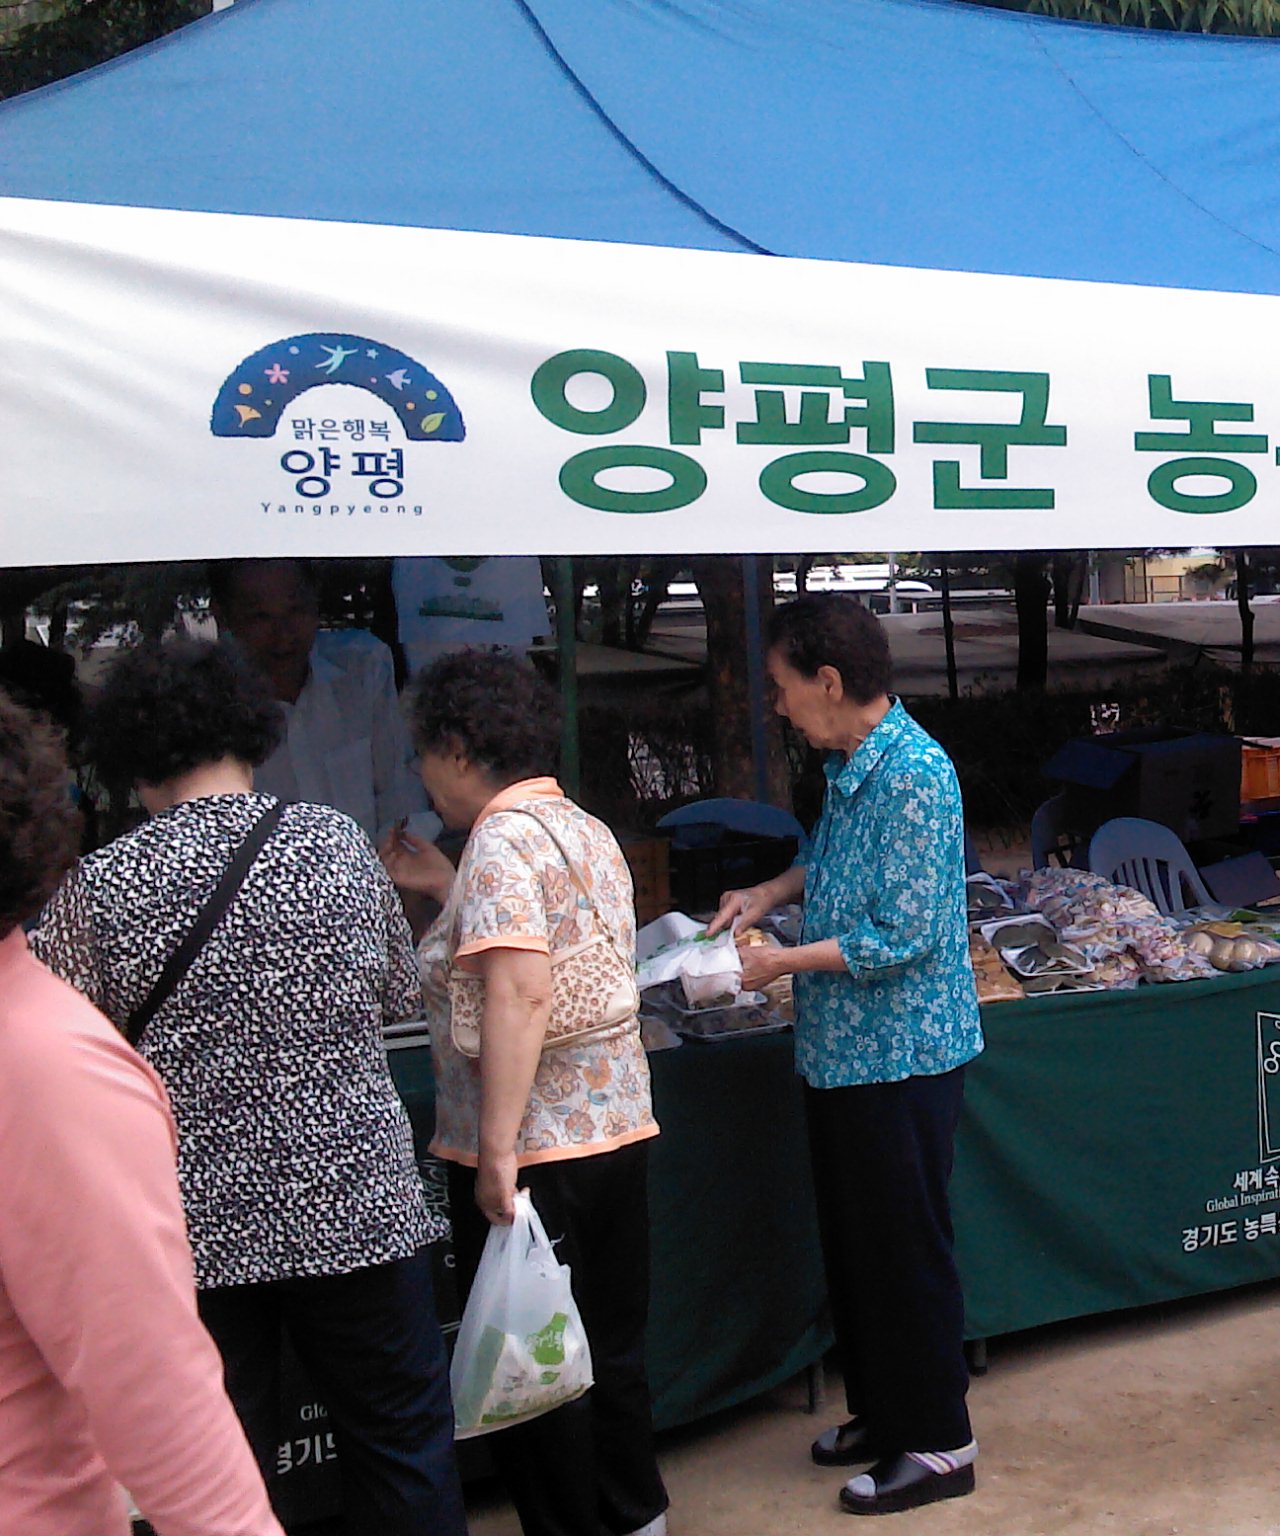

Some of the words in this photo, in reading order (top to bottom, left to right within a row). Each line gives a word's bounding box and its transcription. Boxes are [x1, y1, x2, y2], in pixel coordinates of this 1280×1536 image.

[291, 417, 391, 441] 맑은행복
[530, 348, 1067, 514] 양평군
[281, 447, 404, 498] 양평
[261, 502, 424, 516] Yangpyeong
[1206, 1199, 1239, 1213] Global
[1181, 1220, 1238, 1252] 경기도
